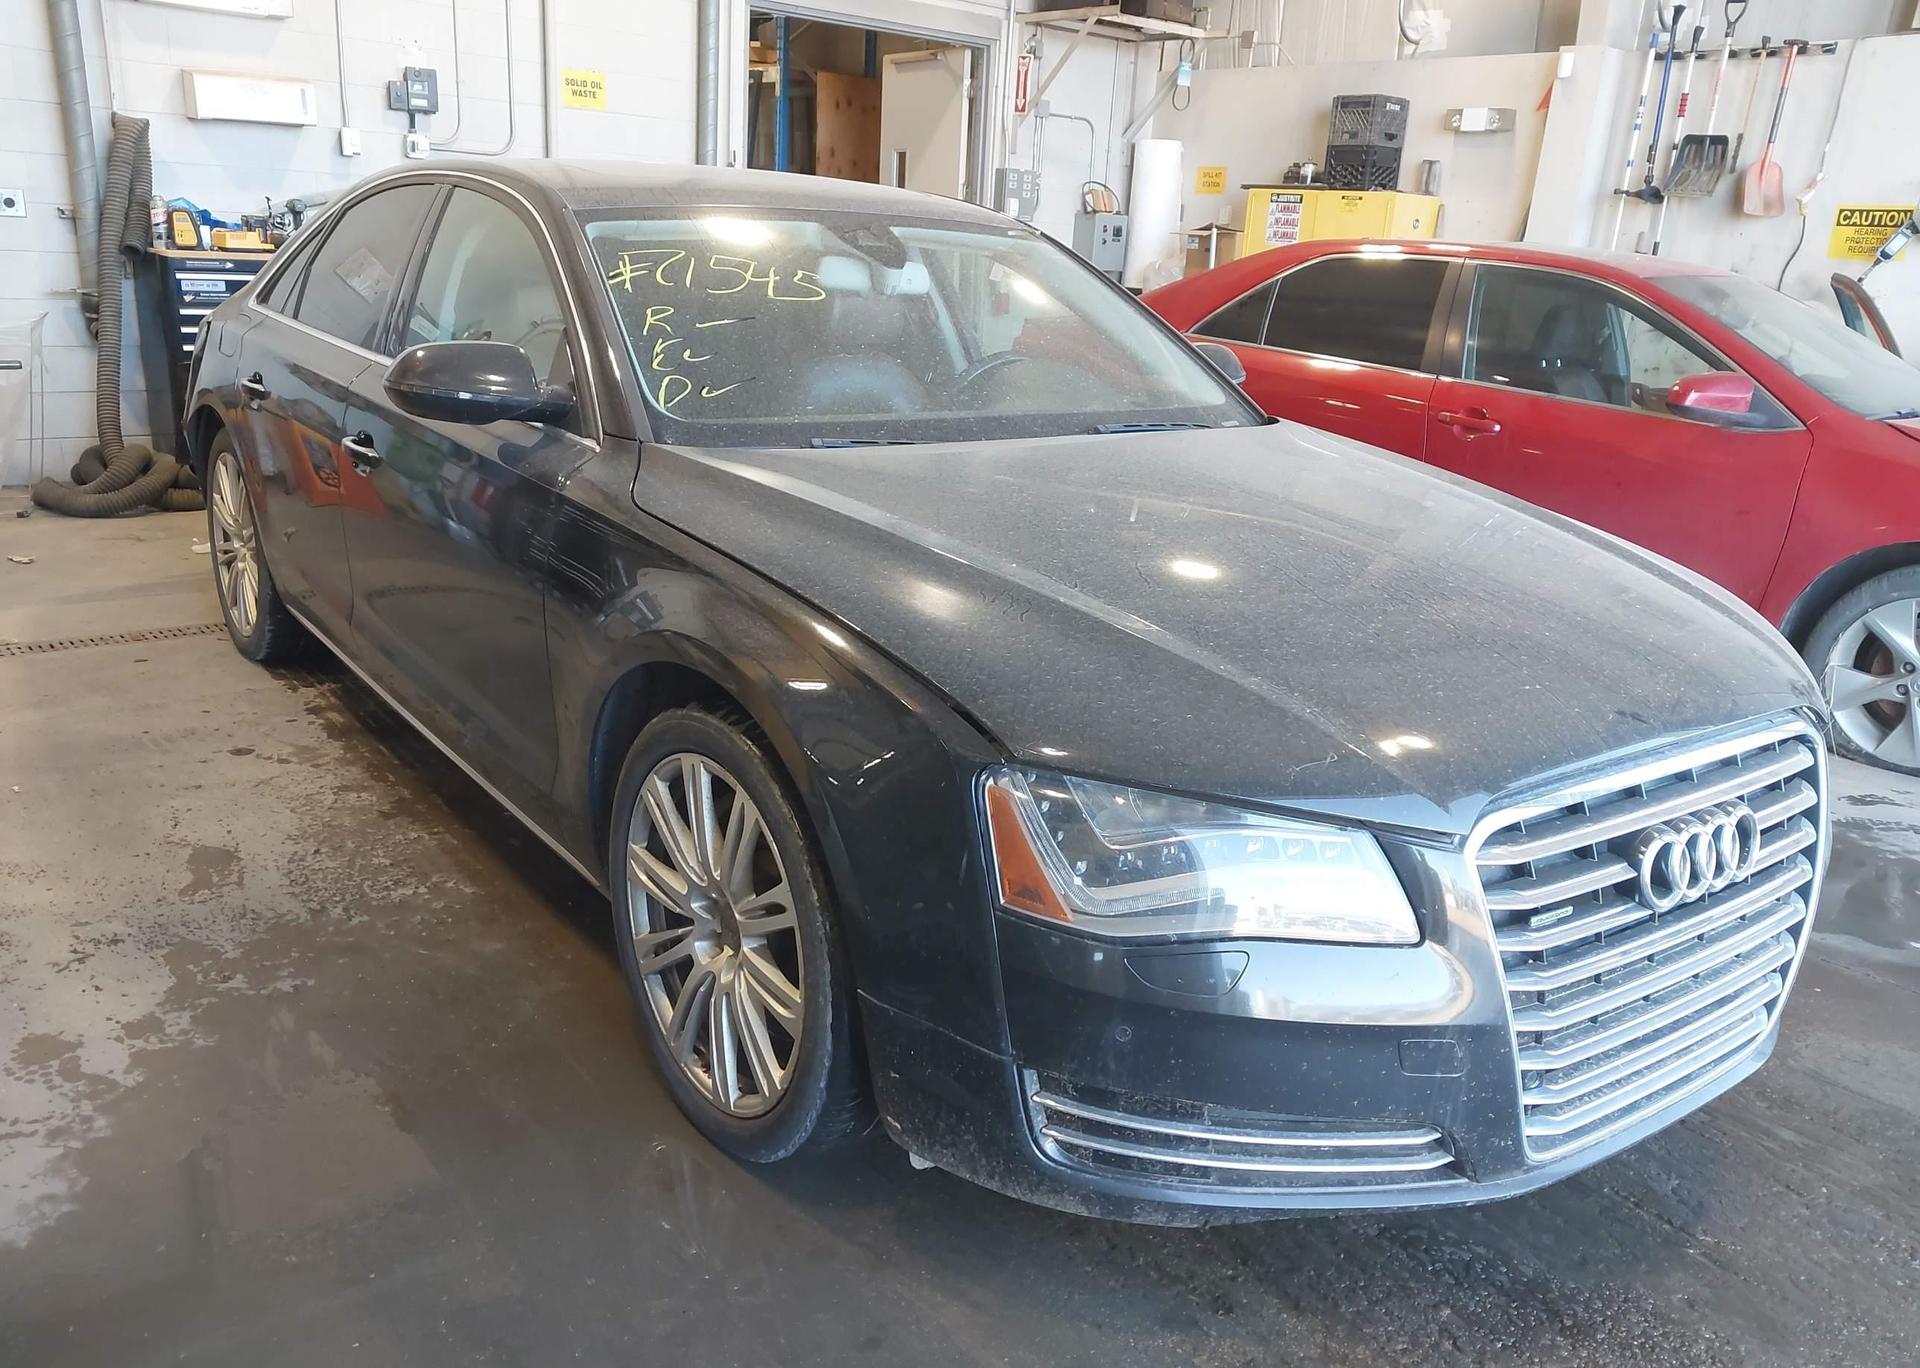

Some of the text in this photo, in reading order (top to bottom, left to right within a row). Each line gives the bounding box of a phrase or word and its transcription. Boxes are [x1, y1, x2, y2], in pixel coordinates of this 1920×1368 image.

[564, 78, 603, 90] SOLID OIL
[571, 89, 597, 99] WASTE
[1839, 210, 1911, 226] CAUTION
[1854, 228, 1888, 237] HEARING
[1845, 237, 1888, 246] PROTECTIO
